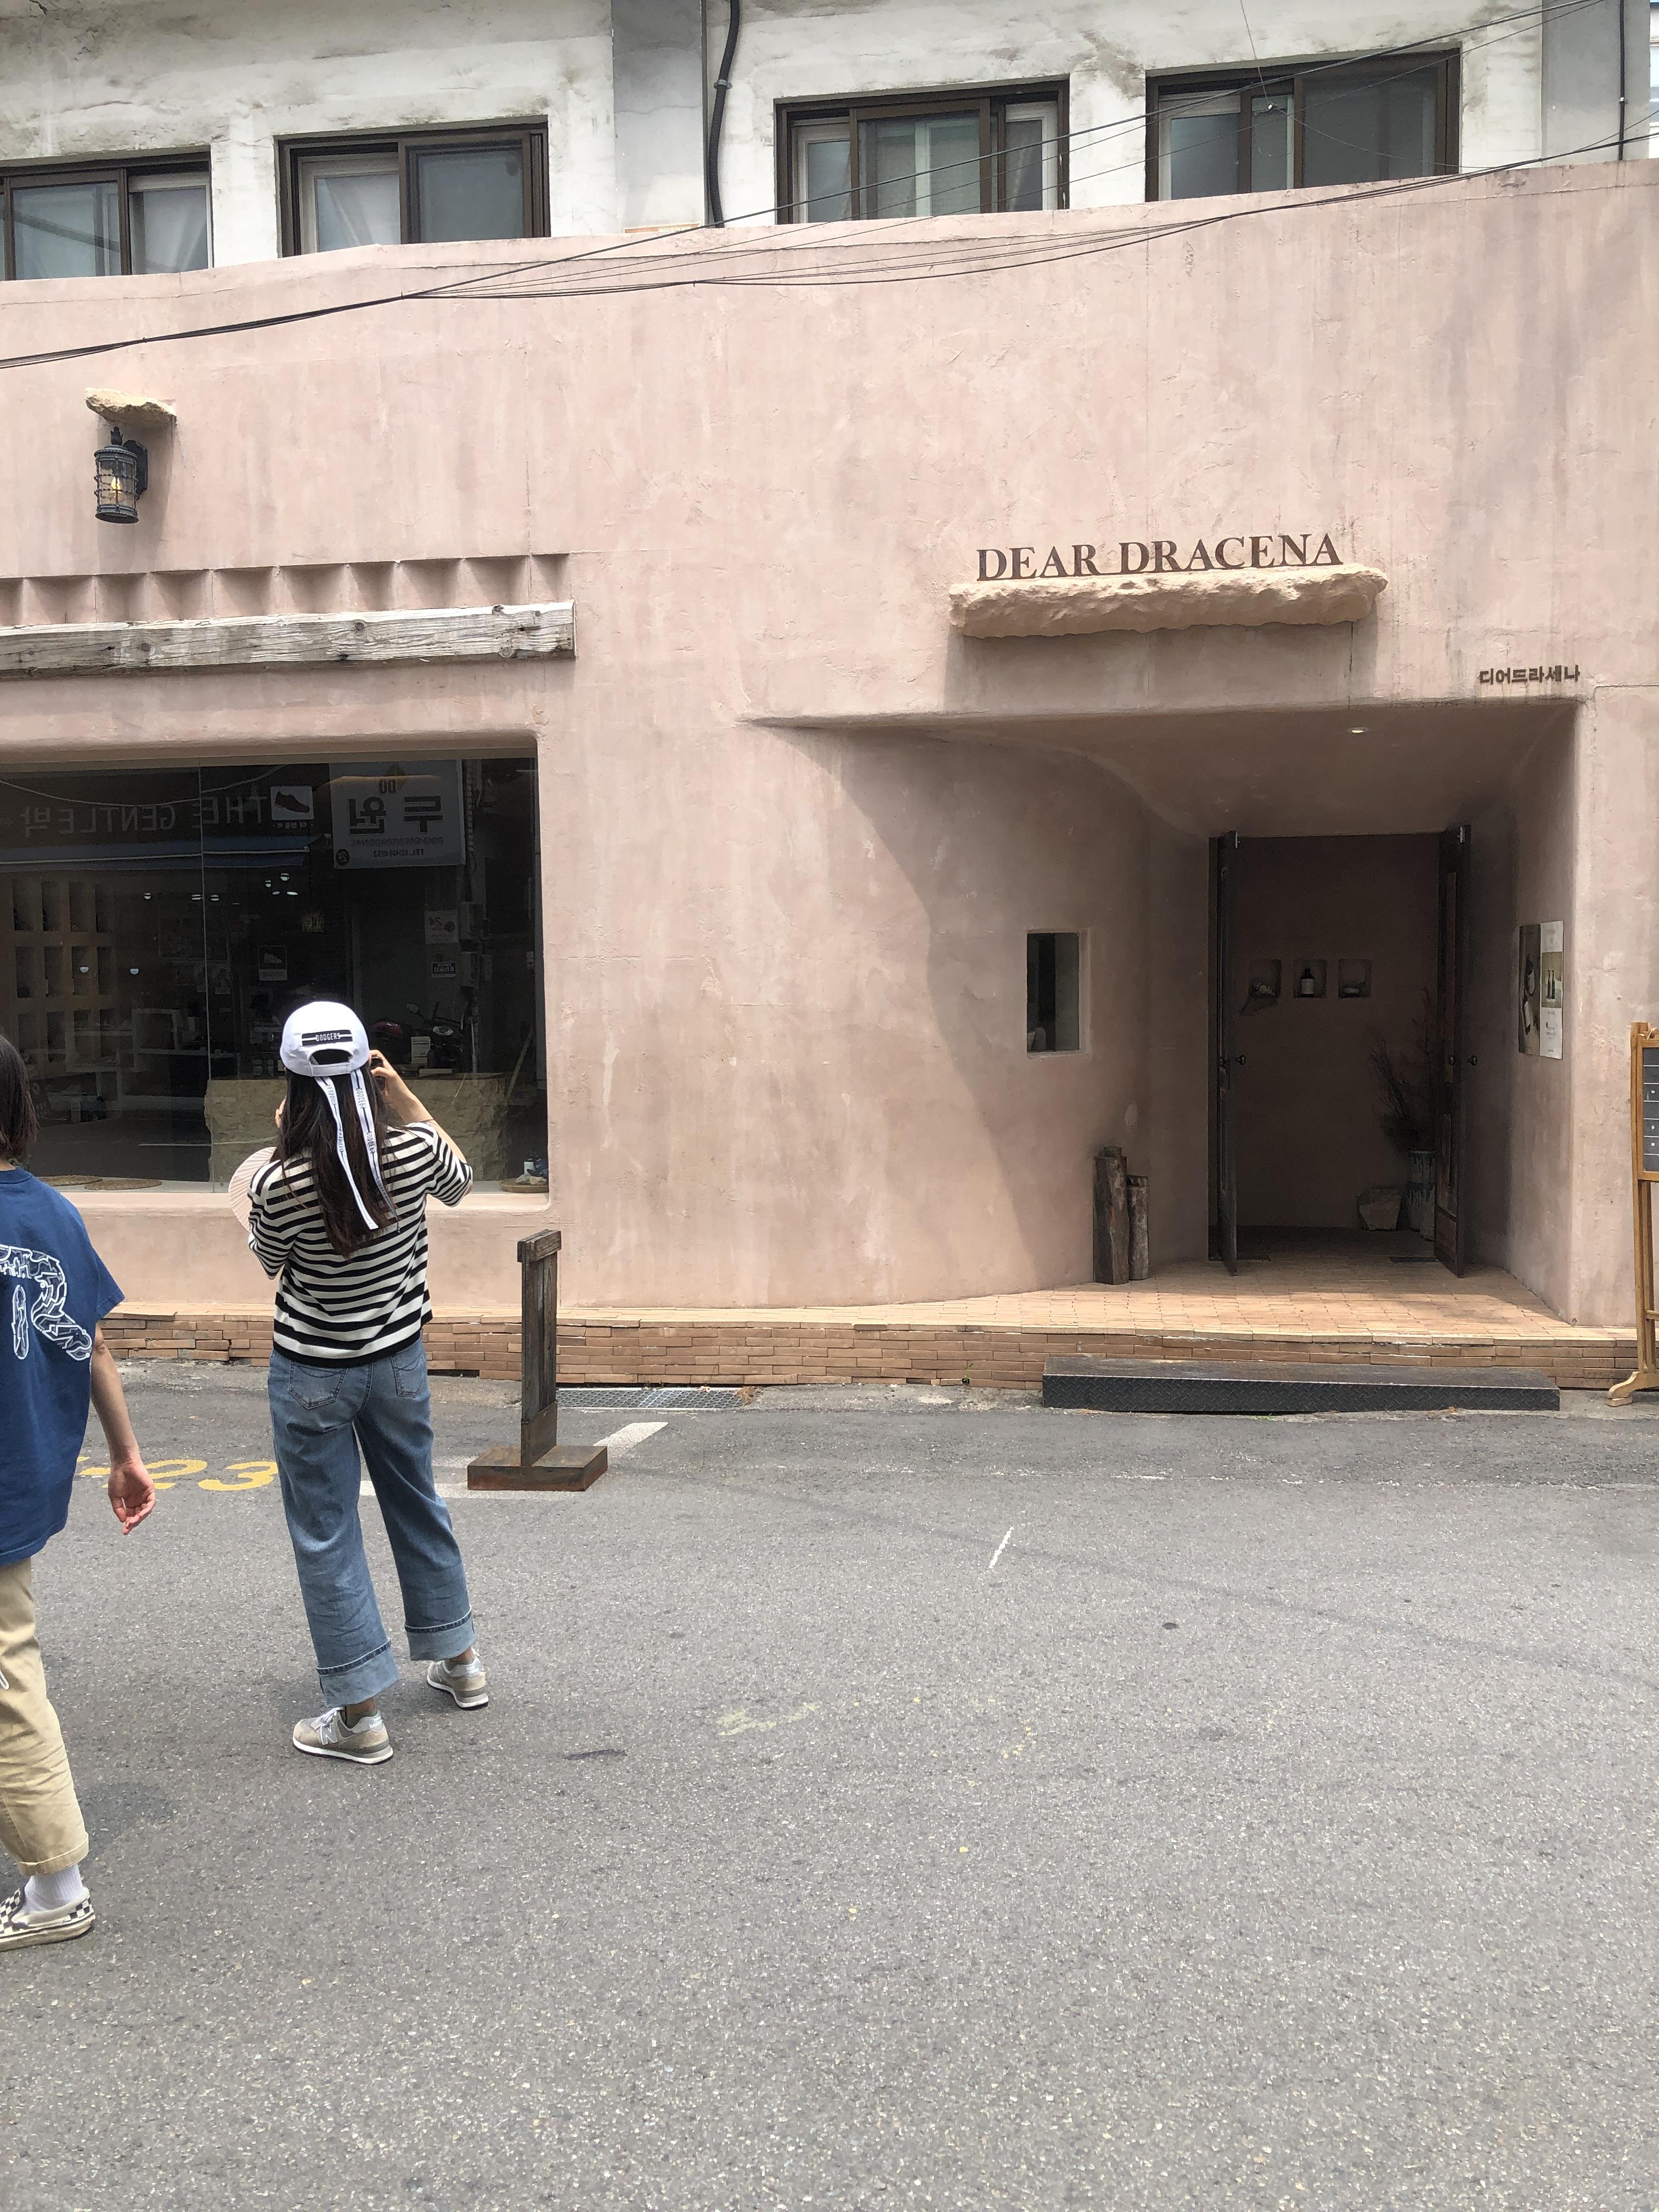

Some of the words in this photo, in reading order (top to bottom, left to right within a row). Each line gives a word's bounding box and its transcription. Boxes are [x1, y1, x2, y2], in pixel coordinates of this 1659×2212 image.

[976, 544, 1098, 582] DEAR
[1119, 533, 1344, 574] DRACENA
[1479, 665, 1581, 685] 디어드라세나
[315, 1032, 341, 1041] DODGERS
[356, 1087, 366, 1109] DODGERS
[366, 1131, 376, 1154] DODGERS
